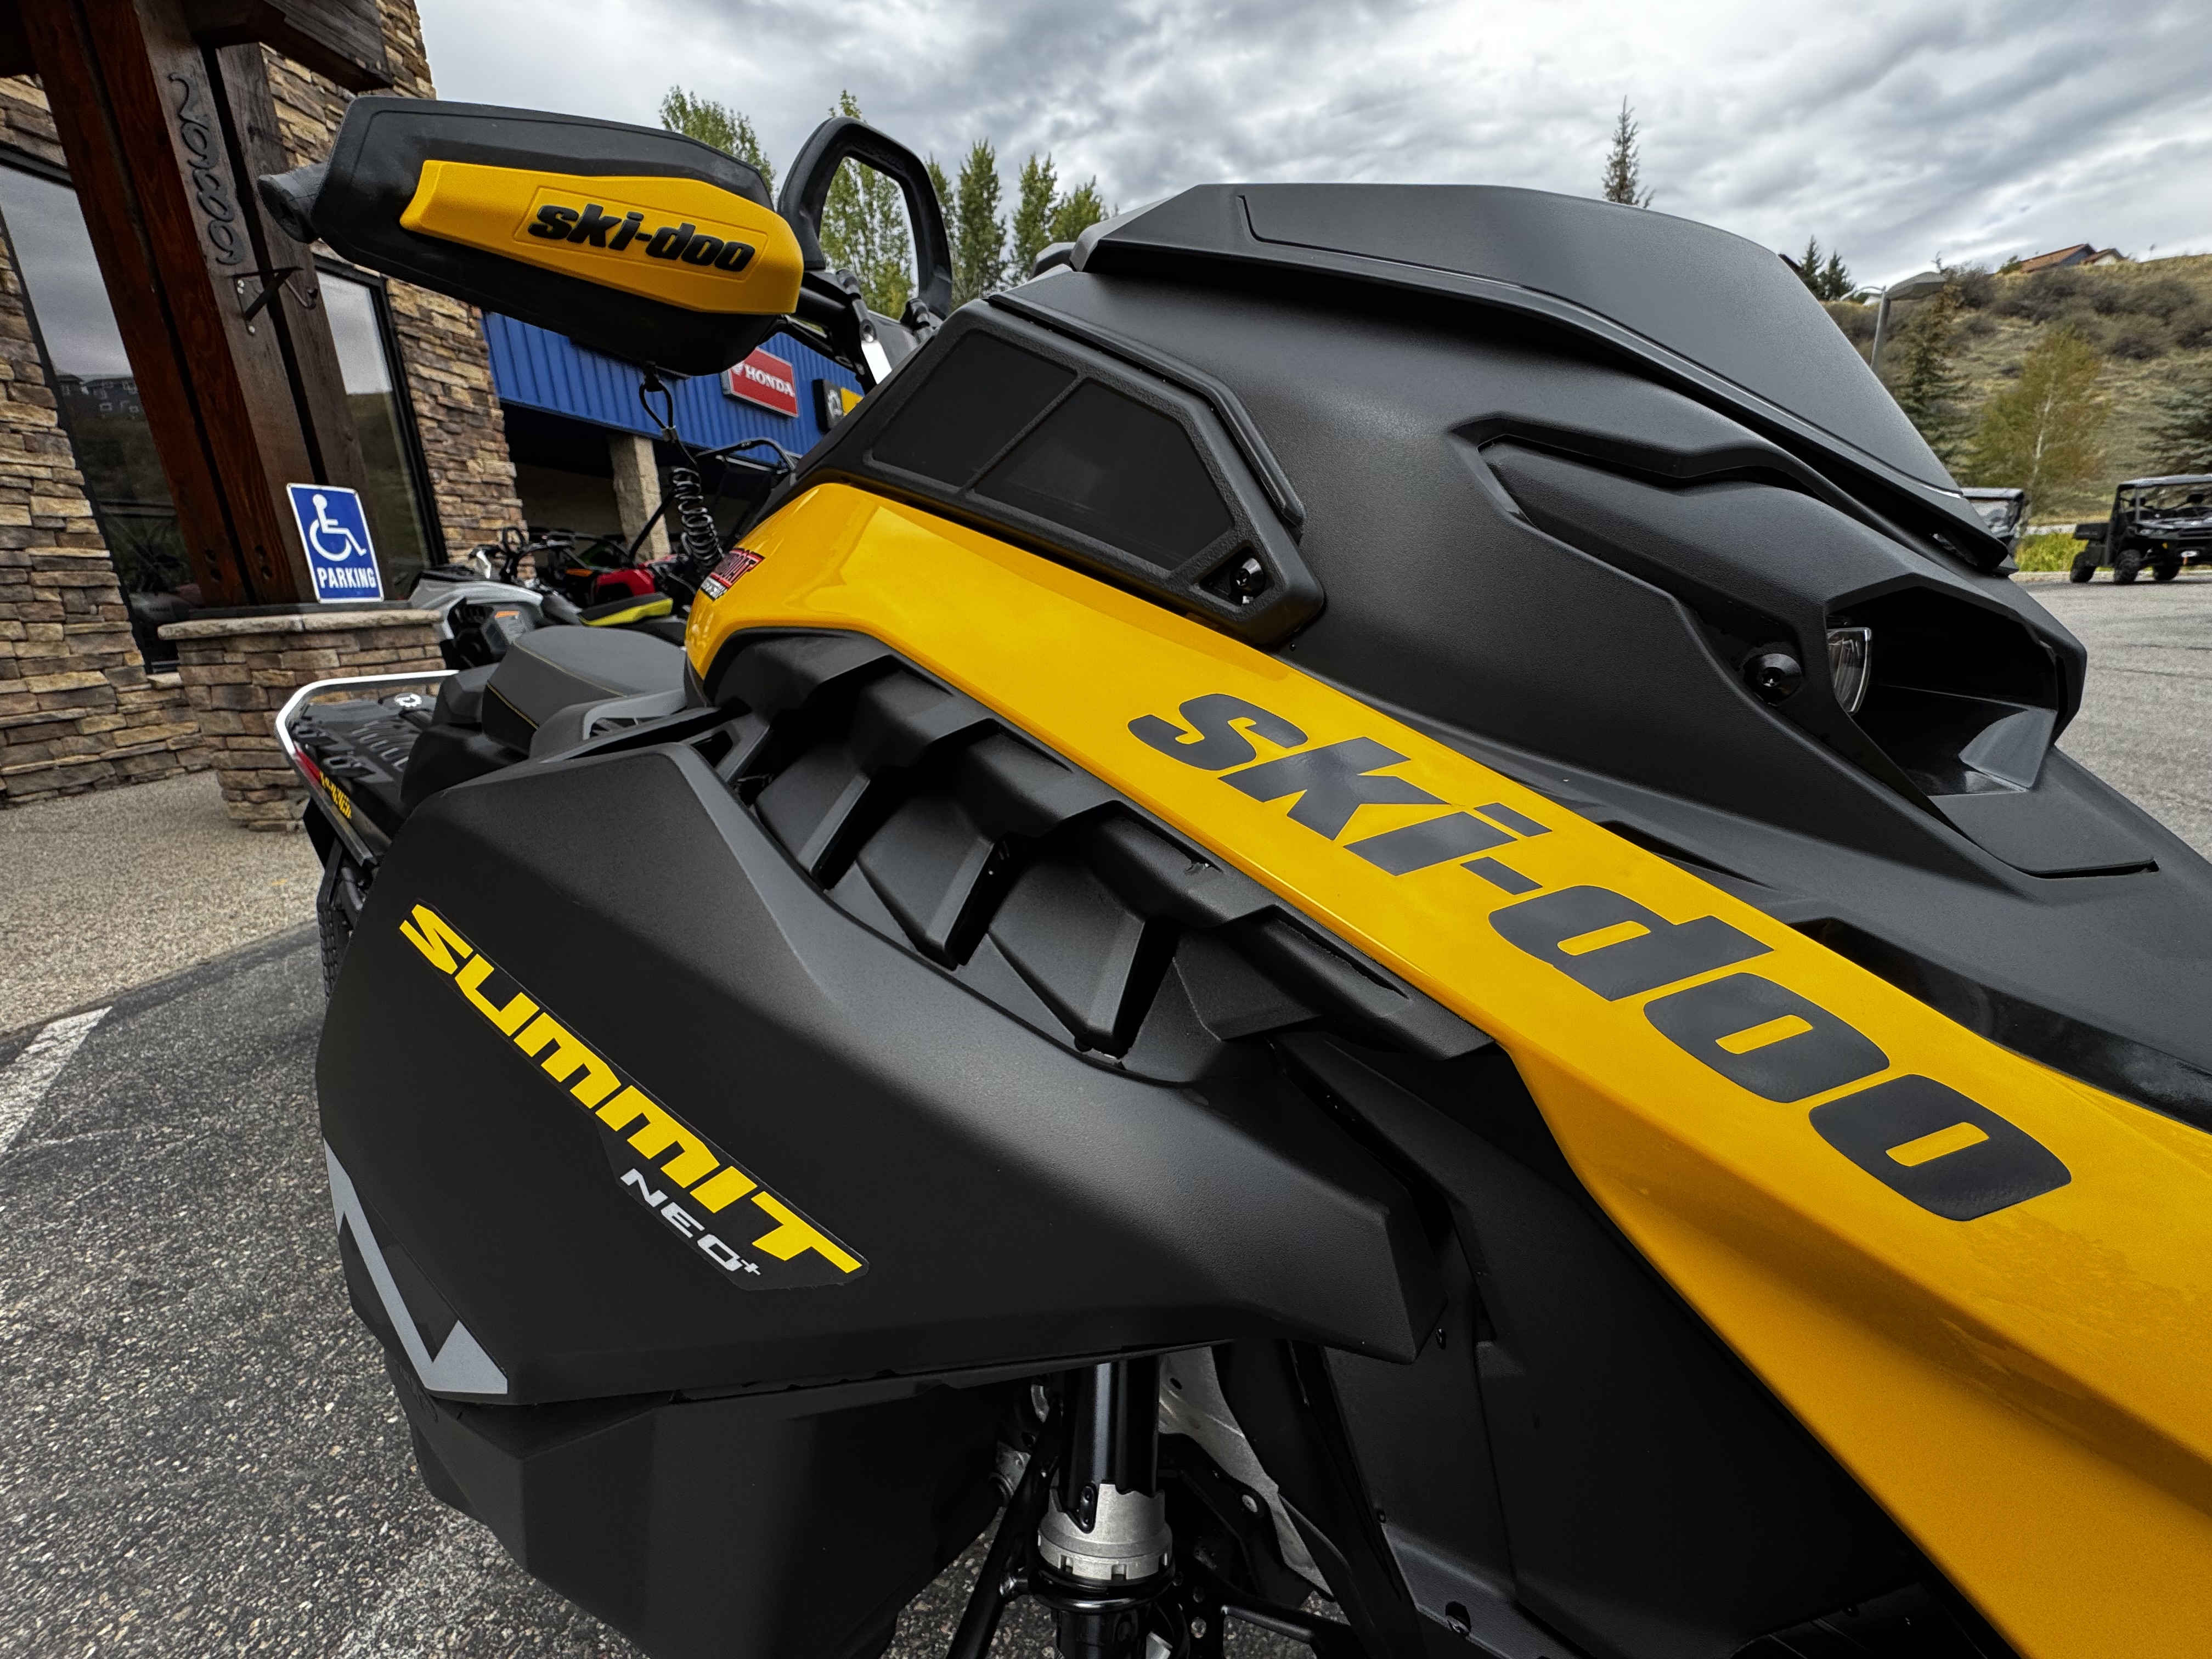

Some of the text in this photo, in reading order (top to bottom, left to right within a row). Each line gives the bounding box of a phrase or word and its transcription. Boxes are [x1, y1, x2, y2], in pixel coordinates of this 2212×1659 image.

[527, 202, 756, 272] ski-doo
[744, 364, 796, 398] HONDA
[317, 567, 377, 589] PARKING
[1127, 692, 2072, 1221] ski-doo
[399, 904, 862, 1273] SUMMIT
